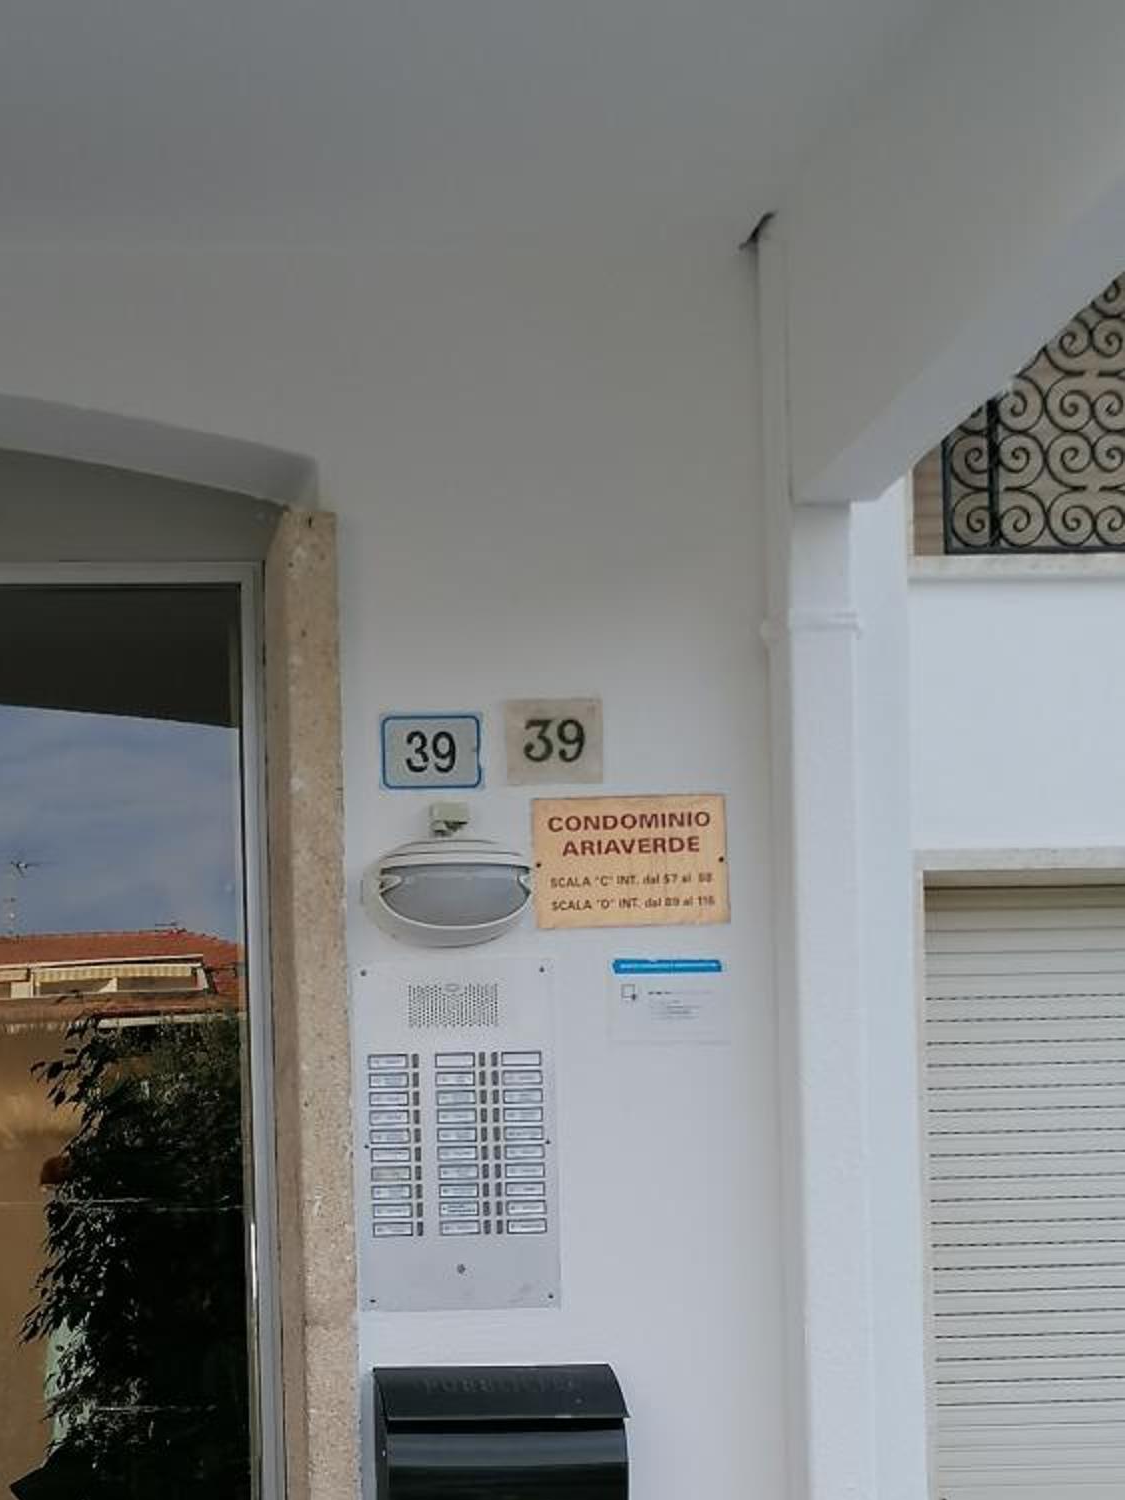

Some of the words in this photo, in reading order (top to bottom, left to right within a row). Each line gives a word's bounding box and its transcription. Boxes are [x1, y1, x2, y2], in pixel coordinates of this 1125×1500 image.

[523, 719, 585, 763] 39
[405, 731, 457, 773] 39
[547, 811, 711, 833] CONDOMINIO
[562, 836, 700, 857] ARIAVERDE
[550, 876, 592, 889] SCALA
[642, 872, 660, 885] dal
[551, 898, 593, 912] SCALA
[644, 896, 662, 908] dal
